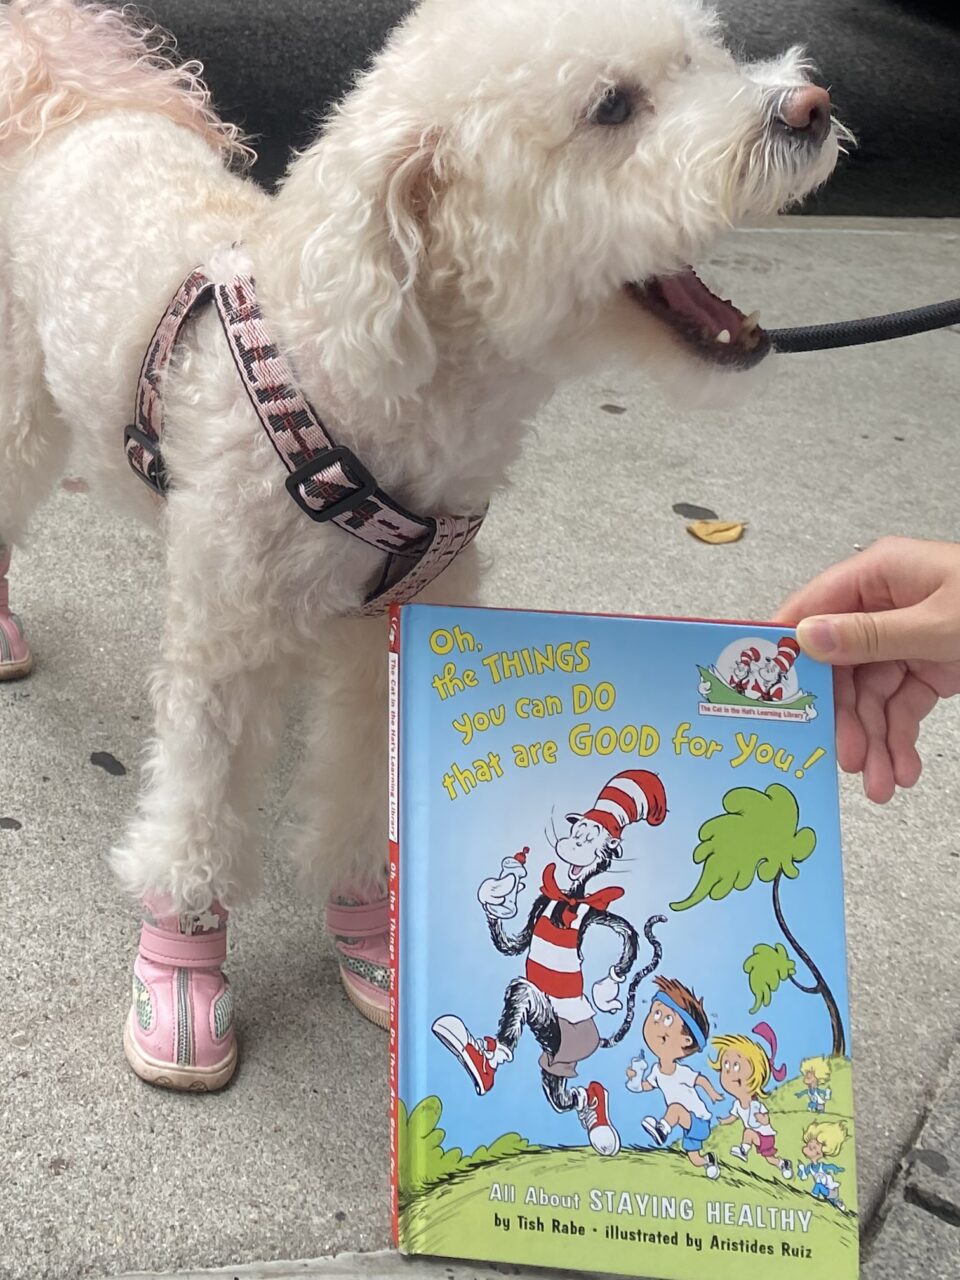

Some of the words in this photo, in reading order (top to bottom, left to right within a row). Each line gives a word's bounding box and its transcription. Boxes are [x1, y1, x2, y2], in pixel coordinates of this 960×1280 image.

[428, 625, 483, 657] Oh,
[431, 662, 479, 703] the
[482, 640, 593, 685] THINGS
[452, 710, 507, 747] you
[515, 695, 564, 721] can
[571, 682, 617, 716] DO
[700, 704, 711, 712] The
[757, 711, 781, 719] Learning
[784, 712, 804, 720] Library
[441, 751, 504, 801] that
[513, 740, 560, 769] are
[567, 723, 661, 758] GOOD
[672, 721, 724, 760] for
[390, 1028, 395, 1046] Do
[489, 1182, 516, 1203] All
[524, 1186, 581, 1209] About
[590, 1188, 694, 1221] STAYING
[705, 1200, 813, 1233] HEALTHY
[494, 1213, 511, 1231] by
[517, 1215, 545, 1232] Tish
[552, 1219, 586, 1236] Rabe
[605, 1225, 678, 1246] illustrated
[686, 1233, 703, 1251] by
[710, 1235, 775, 1255] Aristides
[781, 1242, 813, 1259] Ruiz
